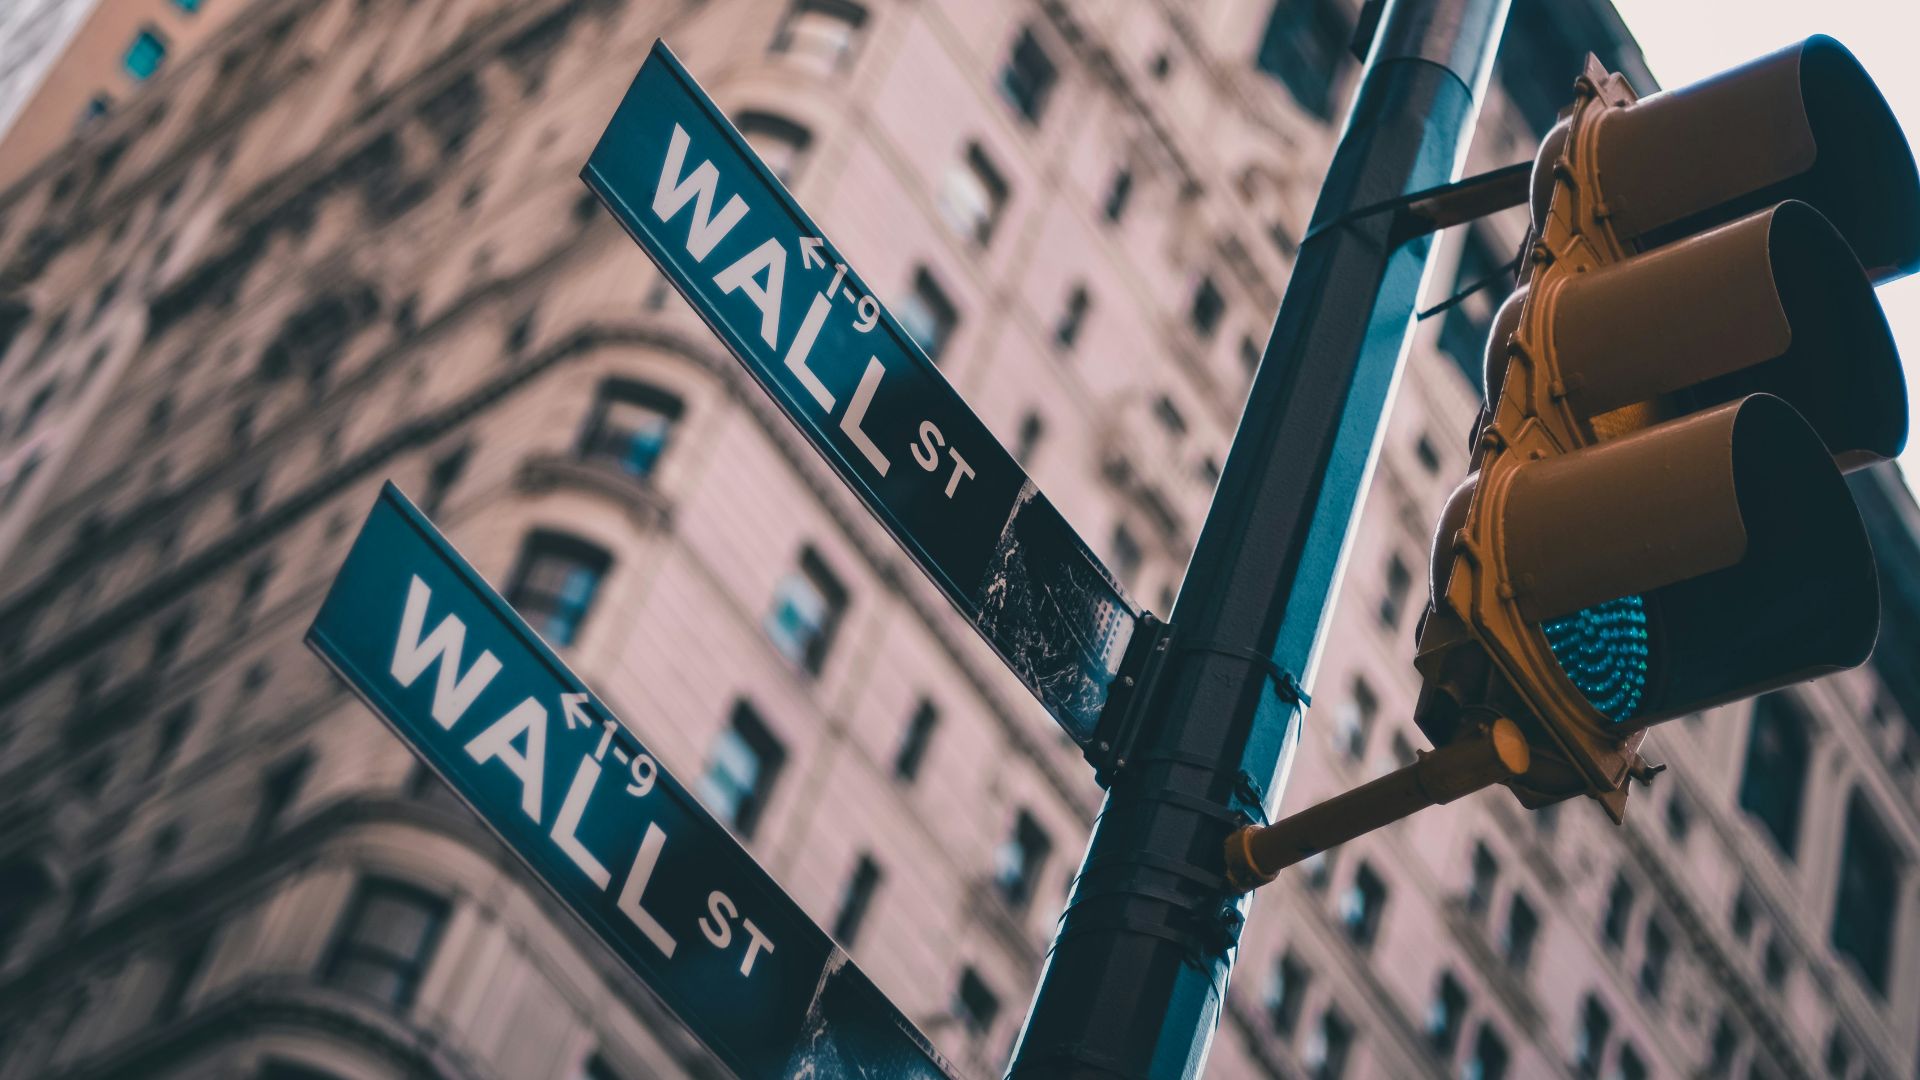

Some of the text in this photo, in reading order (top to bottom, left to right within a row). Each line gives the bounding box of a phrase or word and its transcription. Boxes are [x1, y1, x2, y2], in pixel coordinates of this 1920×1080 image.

[651, 122, 976, 499] WALL ST
[826, 263, 881, 333] 1-9
[390, 573, 775, 977] WALL ST
[594, 720, 658, 797] 1-9
